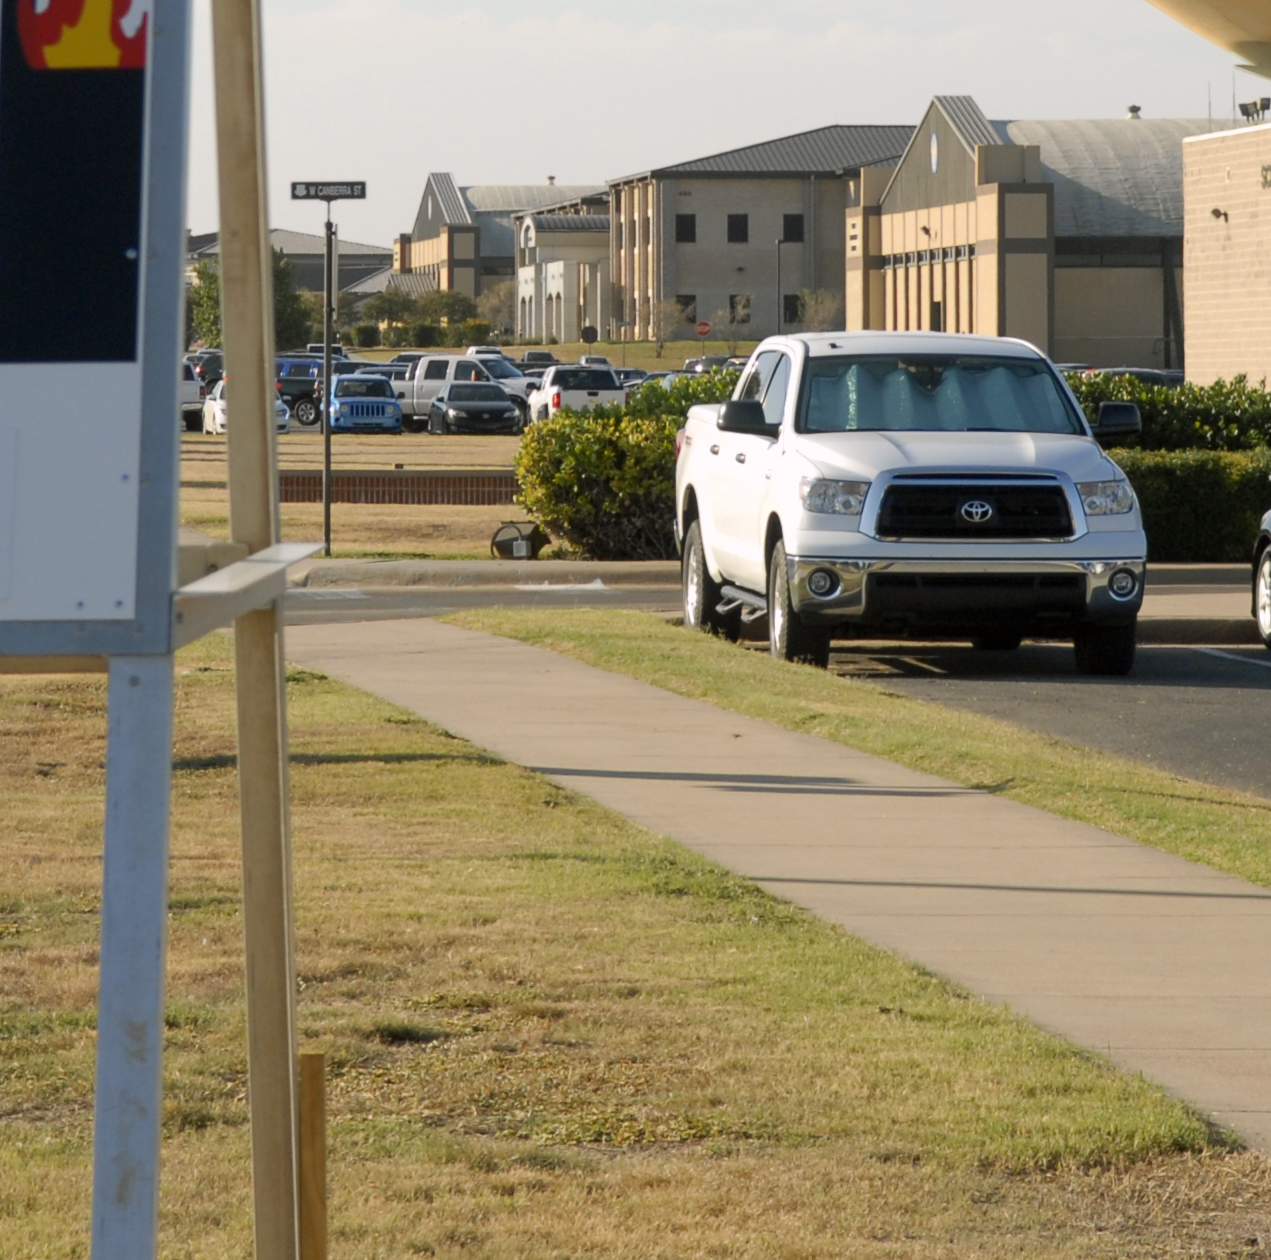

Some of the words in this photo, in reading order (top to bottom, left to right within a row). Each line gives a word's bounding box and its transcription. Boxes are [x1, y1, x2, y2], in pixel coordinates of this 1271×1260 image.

[309, 186, 316, 197] W
[317, 185, 352, 196] CANBERRA
[353, 185, 362, 196] ST
